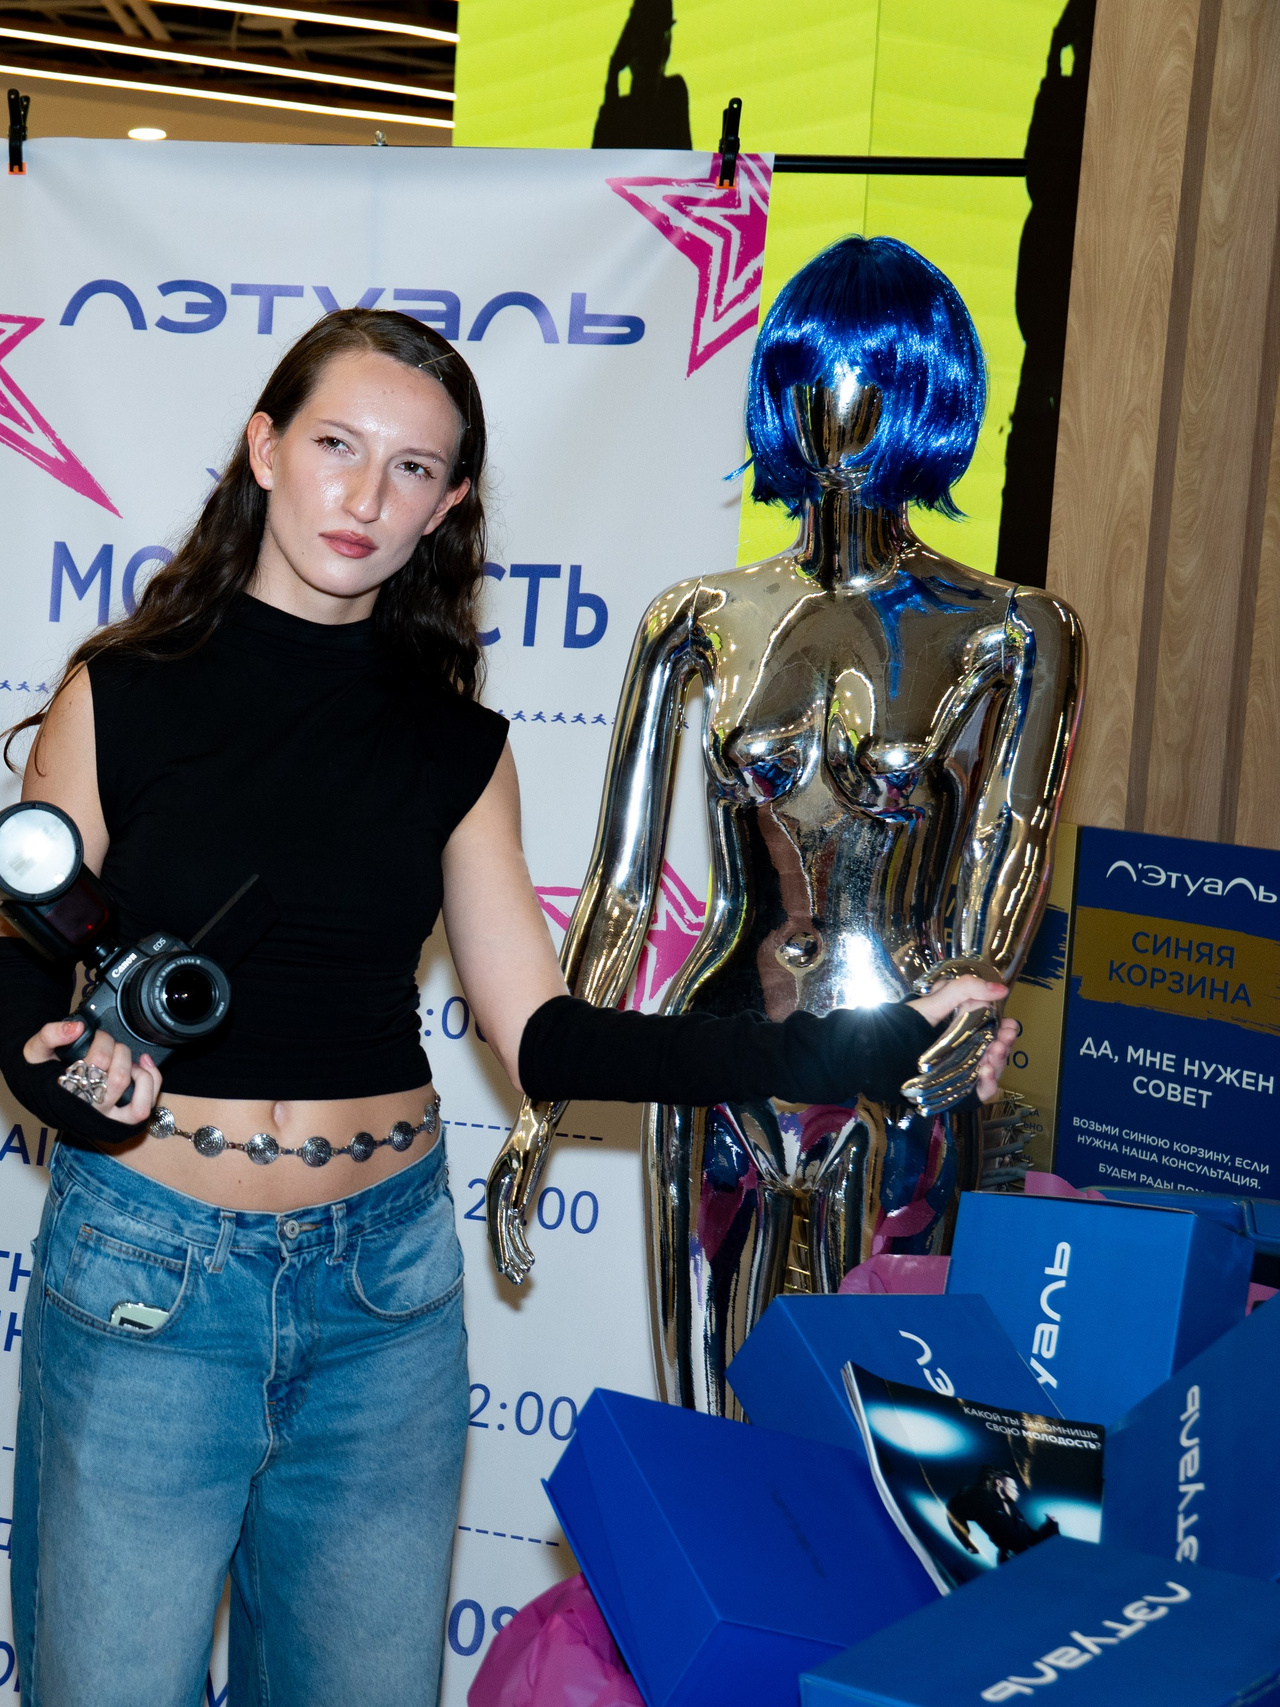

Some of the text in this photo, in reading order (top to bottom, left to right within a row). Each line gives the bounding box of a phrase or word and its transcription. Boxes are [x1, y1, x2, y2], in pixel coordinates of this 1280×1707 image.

[48, 541, 609, 651] МОСТЬ
[152, 938, 167, 951] EOS
[1132, 931, 1235, 969] СИНЯЯ
[111, 952, 138, 978] Canon
[1109, 960, 1251, 1008] КОРЗИНА
[1080, 1037, 1274, 1095] ДА, МНЕ НУЖЕН
[1133, 1076, 1212, 1109] СОВЕТ
[1073, 1116, 1270, 1174] ВОЗЬМИ СИНЮЮ КОРЗИНУ, ЕСЛИ
[1077, 1134, 1119, 1153] НУЖНА
[1122, 1145, 1158, 1163] НАША
[1162, 1156, 1261, 1190] КОНСУЛЬТАЦИЯ.
[1098, 1163, 1136, 1181] БУДЕМ
[1140, 1174, 1174, 1190] РАДЫ
[963, 1406, 1099, 1439] КАКОЙ ТЫ ЗАПОМНИШЬ
[986, 1422, 1101, 1450] СВОЮ МОЛОДОСТЬ?
